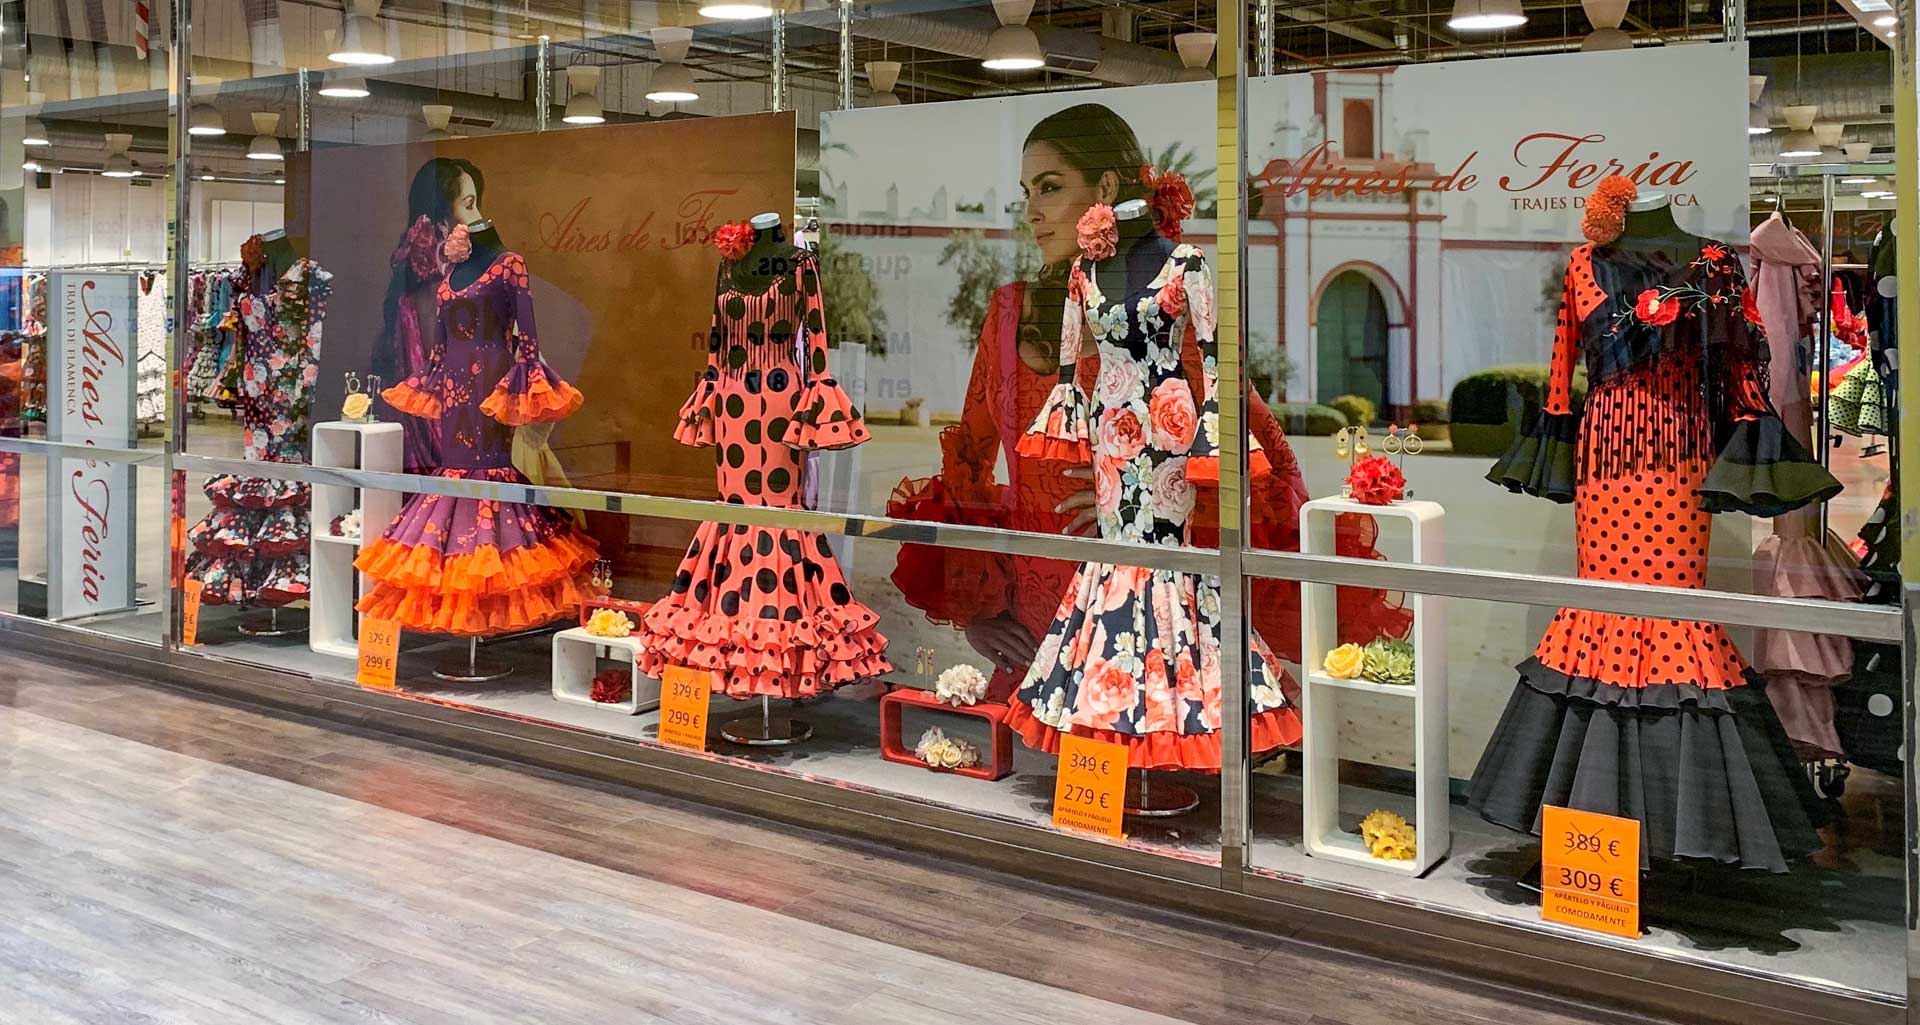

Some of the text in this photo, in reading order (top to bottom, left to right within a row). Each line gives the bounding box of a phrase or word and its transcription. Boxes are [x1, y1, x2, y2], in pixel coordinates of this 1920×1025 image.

[1247, 132, 1700, 198] Aires de Feria
[1511, 197, 1568, 213] TRAJES
[522, 196, 611, 253] Aires
[617, 211, 655, 253] de
[65, 282, 76, 416] TRAJES DE FLAMENCA
[81, 279, 125, 431] Aires
[72, 469, 110, 605] Feria
[365, 655, 391, 671] 299 €
[672, 682, 701, 700] 379 €
[668, 709, 701, 729] 299 €
[1070, 753, 1110, 775] 349 €
[1064, 784, 1110, 809] 279 €
[1564, 831, 1621, 857] 389 €
[1559, 867, 1624, 897] 309 €
